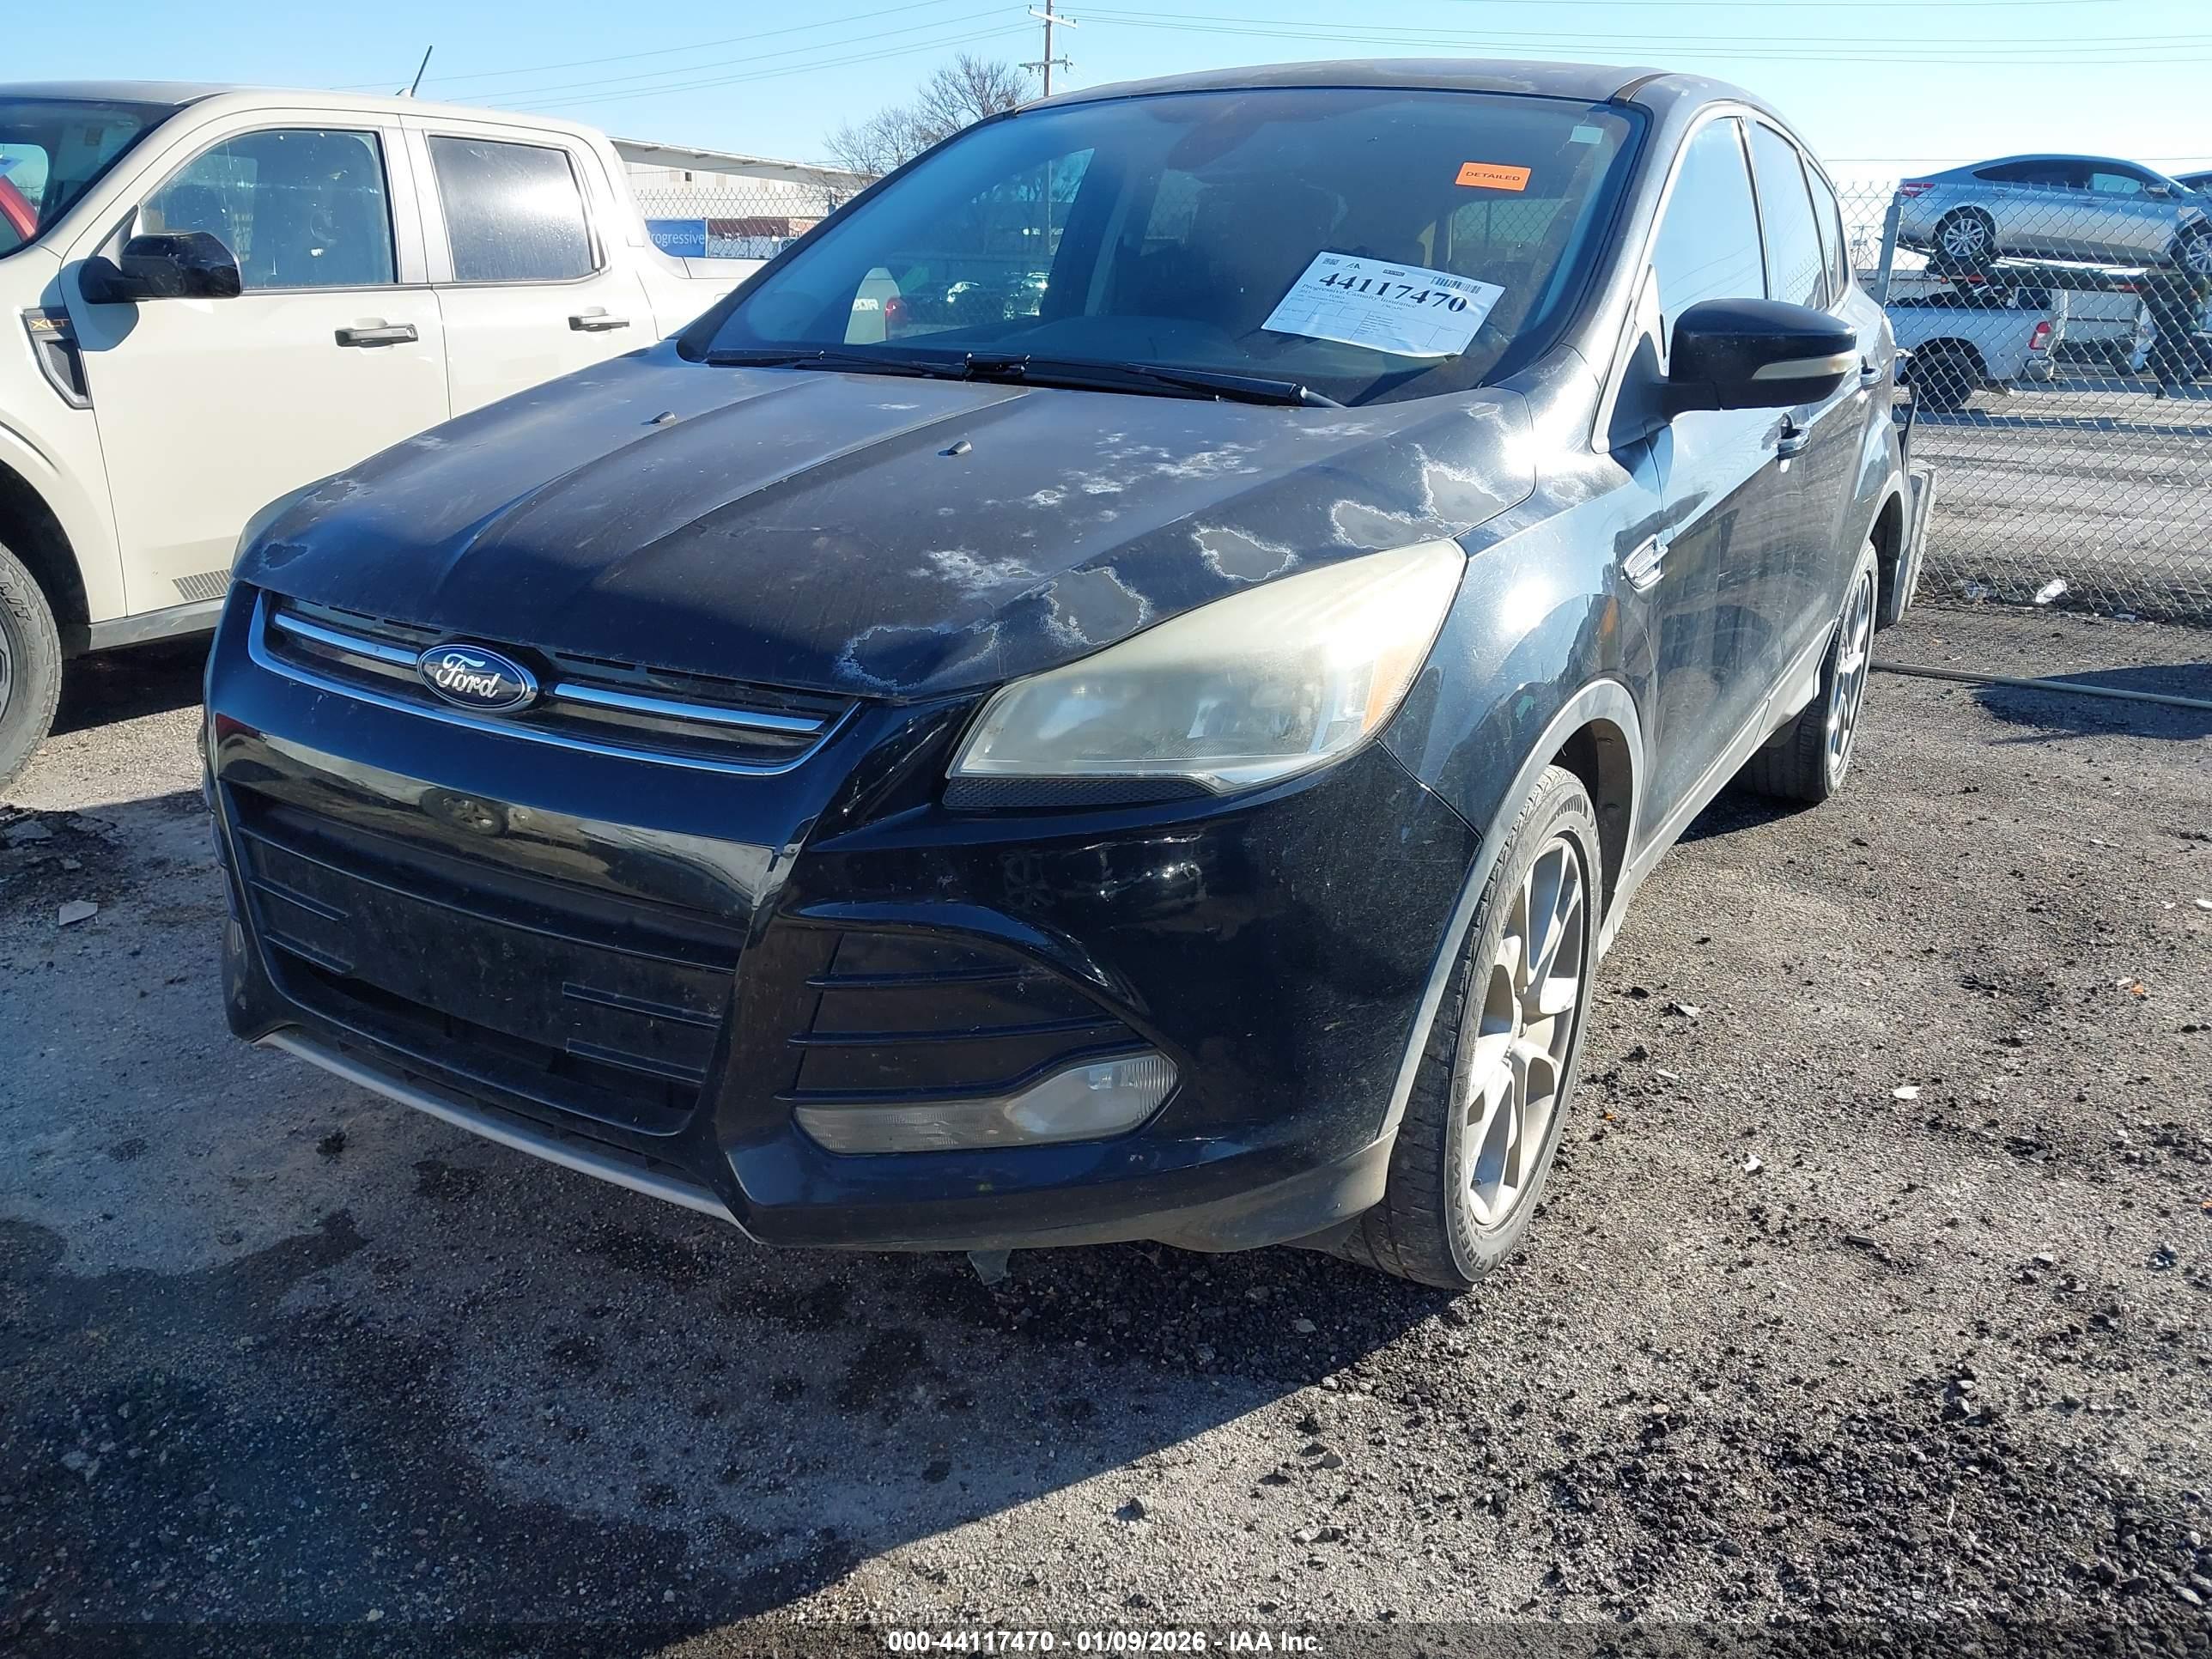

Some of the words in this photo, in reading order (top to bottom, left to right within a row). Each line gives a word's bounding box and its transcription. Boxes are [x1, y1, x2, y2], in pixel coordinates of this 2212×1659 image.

[1466, 171, 1521, 181] DETAILED
[651, 230, 705, 247] rogressive
[1302, 284, 1346, 295] Progressive
[1346, 290, 1377, 301] Casualty
[1381, 295, 1418, 309] Insurance
[1319, 272, 1468, 313] 44117470
[29, 318, 70, 330] XLT
[435, 653, 501, 699] Ford
